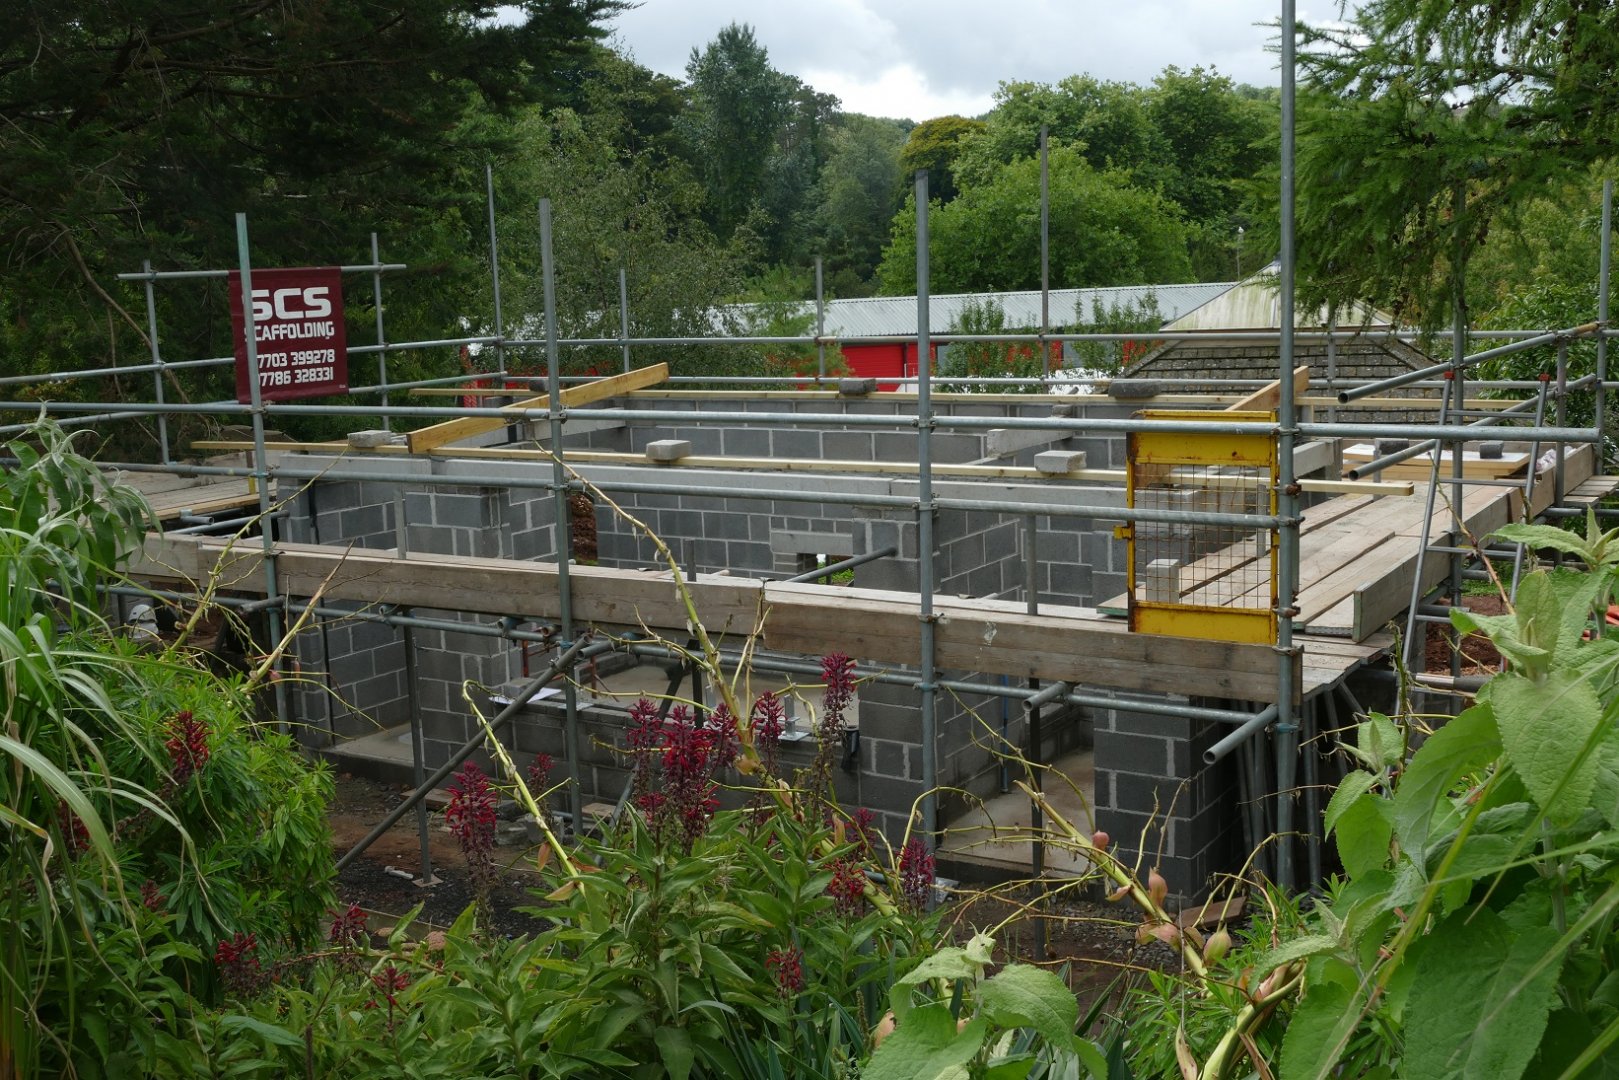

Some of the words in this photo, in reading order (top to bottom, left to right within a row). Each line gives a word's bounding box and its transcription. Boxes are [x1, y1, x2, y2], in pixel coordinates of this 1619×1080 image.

[242, 287, 332, 321] SCS
[244, 321, 335, 342] CAFFOLDING
[255, 352, 288, 368] 7703
[290, 349, 335, 366] 399278
[258, 370, 291, 387] 7786
[294, 366, 334, 384] 328331
